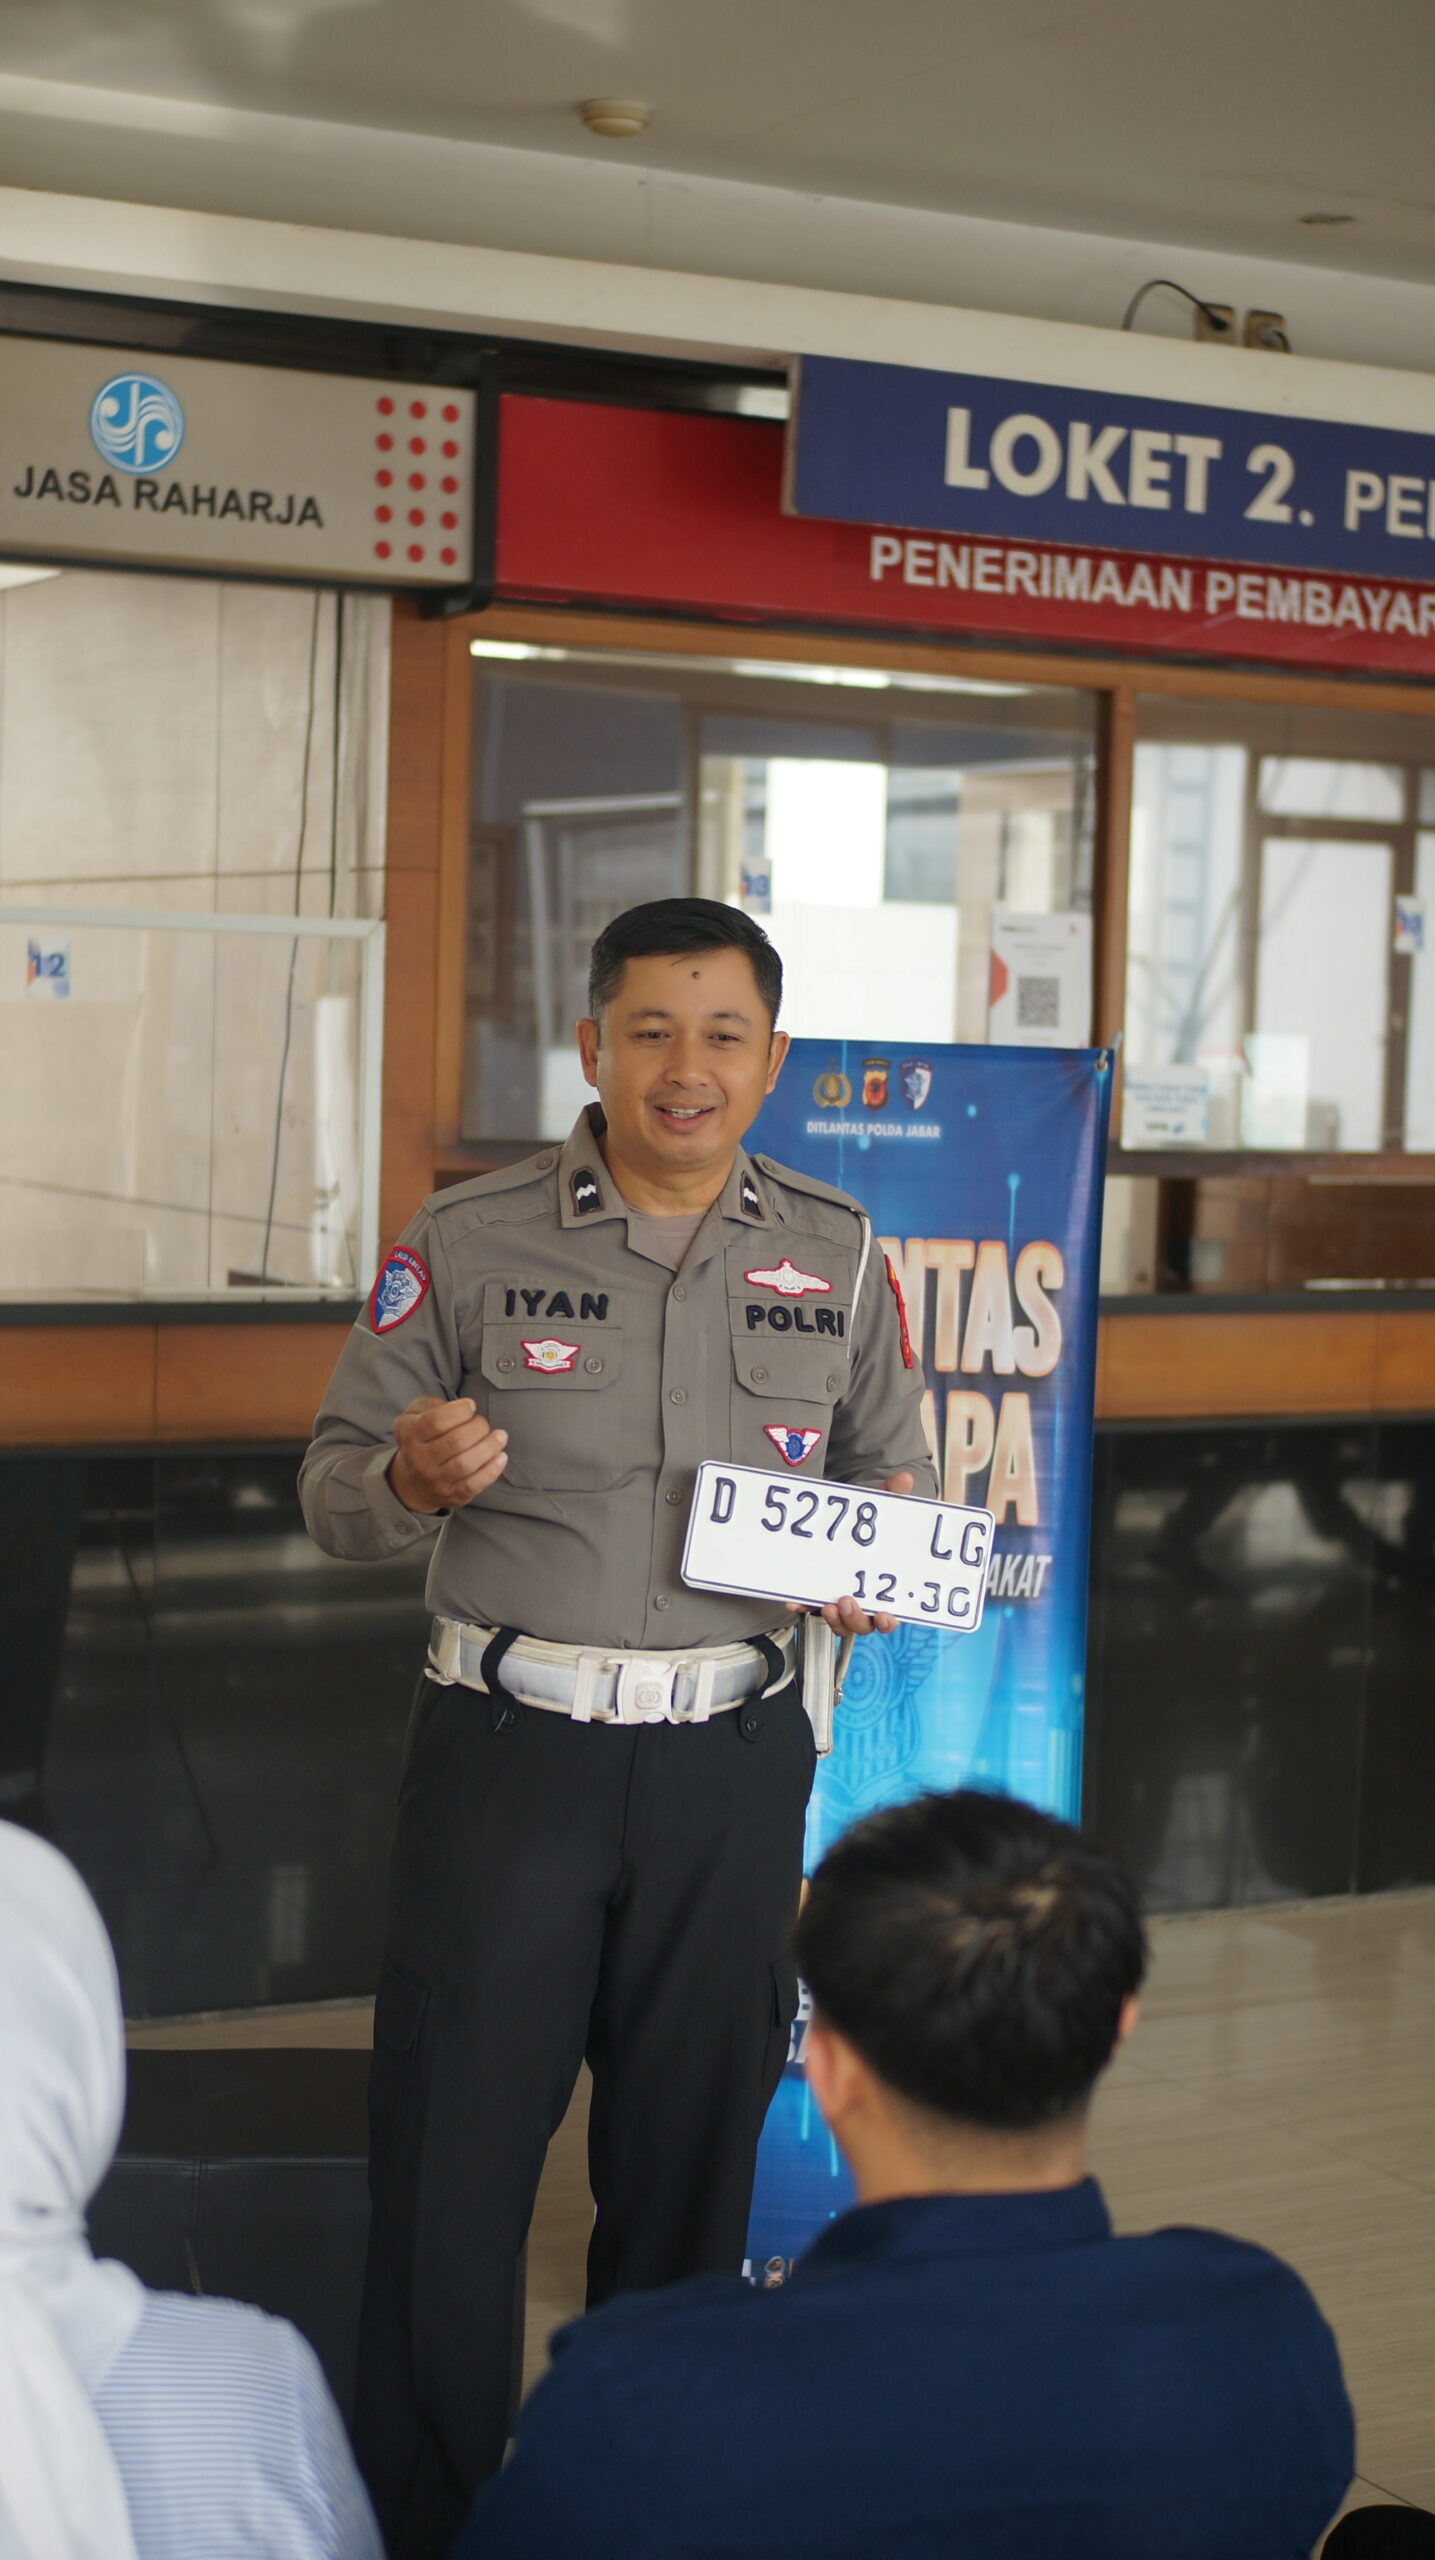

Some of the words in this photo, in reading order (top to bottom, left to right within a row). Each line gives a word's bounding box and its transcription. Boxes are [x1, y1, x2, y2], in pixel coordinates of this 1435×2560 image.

[944, 407, 1222, 513] LOKET
[1244, 444, 1315, 527] 2.
[14, 465, 121, 508] JASA
[133, 477, 325, 528] RAHARJA
[870, 536, 1192, 612] PENERIMAAN
[32, 952, 66, 979] 12
[806, 1120, 865, 1136] DITLANTAS
[866, 1123, 903, 1137] POLDA
[905, 1124, 941, 1138] JABAR
[506, 1289, 609, 1320] IYAN
[746, 1304, 845, 1337] POLRI
[709, 1476, 737, 1524] D
[761, 1484, 878, 1547] 5278
[930, 1513, 987, 1568] LG
